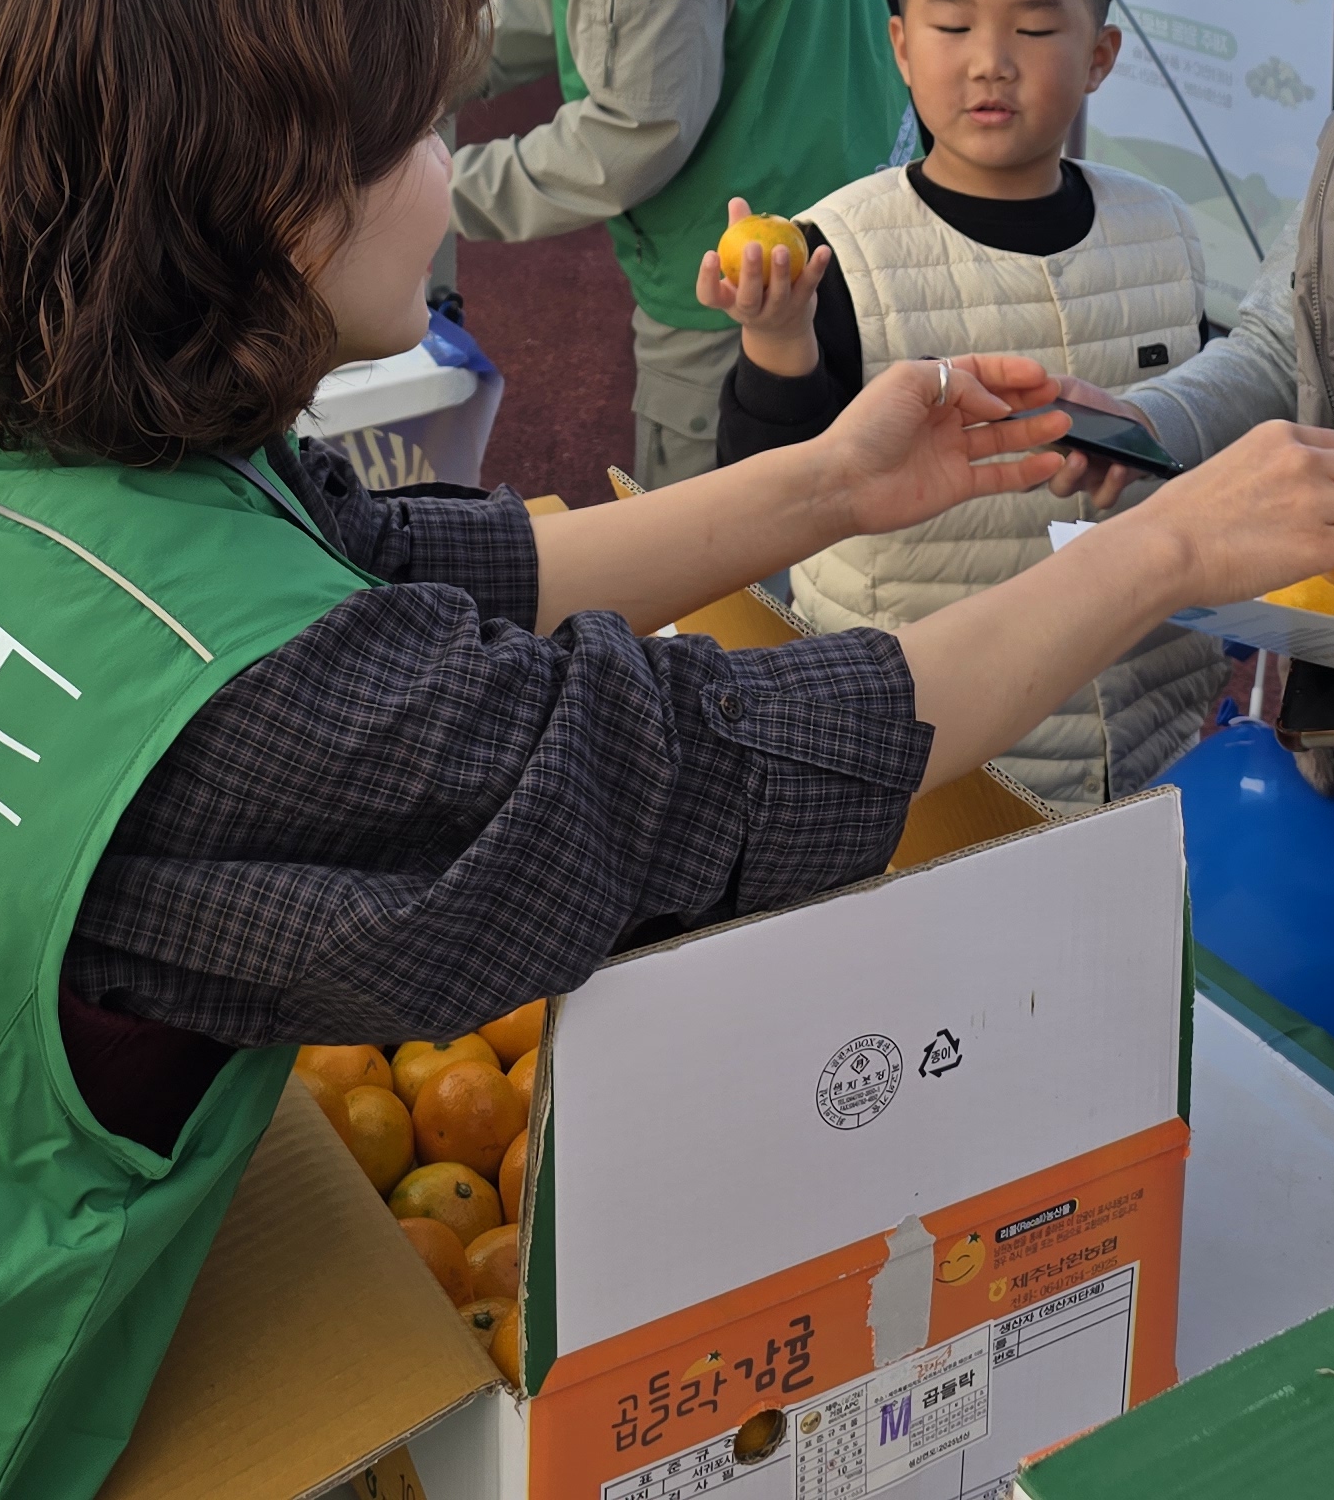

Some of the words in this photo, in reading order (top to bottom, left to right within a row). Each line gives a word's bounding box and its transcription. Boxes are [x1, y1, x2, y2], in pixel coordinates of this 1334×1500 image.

[1009, 1235, 1119, 1293] 제주남원농협
[998, 1311, 1035, 1336] 생산자
[1038, 1281, 1106, 1319] (생산자단체)
[611, 1369, 728, 1452] 곱들락
[733, 1314, 816, 1394] 감귤
[922, 1369, 976, 1409] 곱들락
